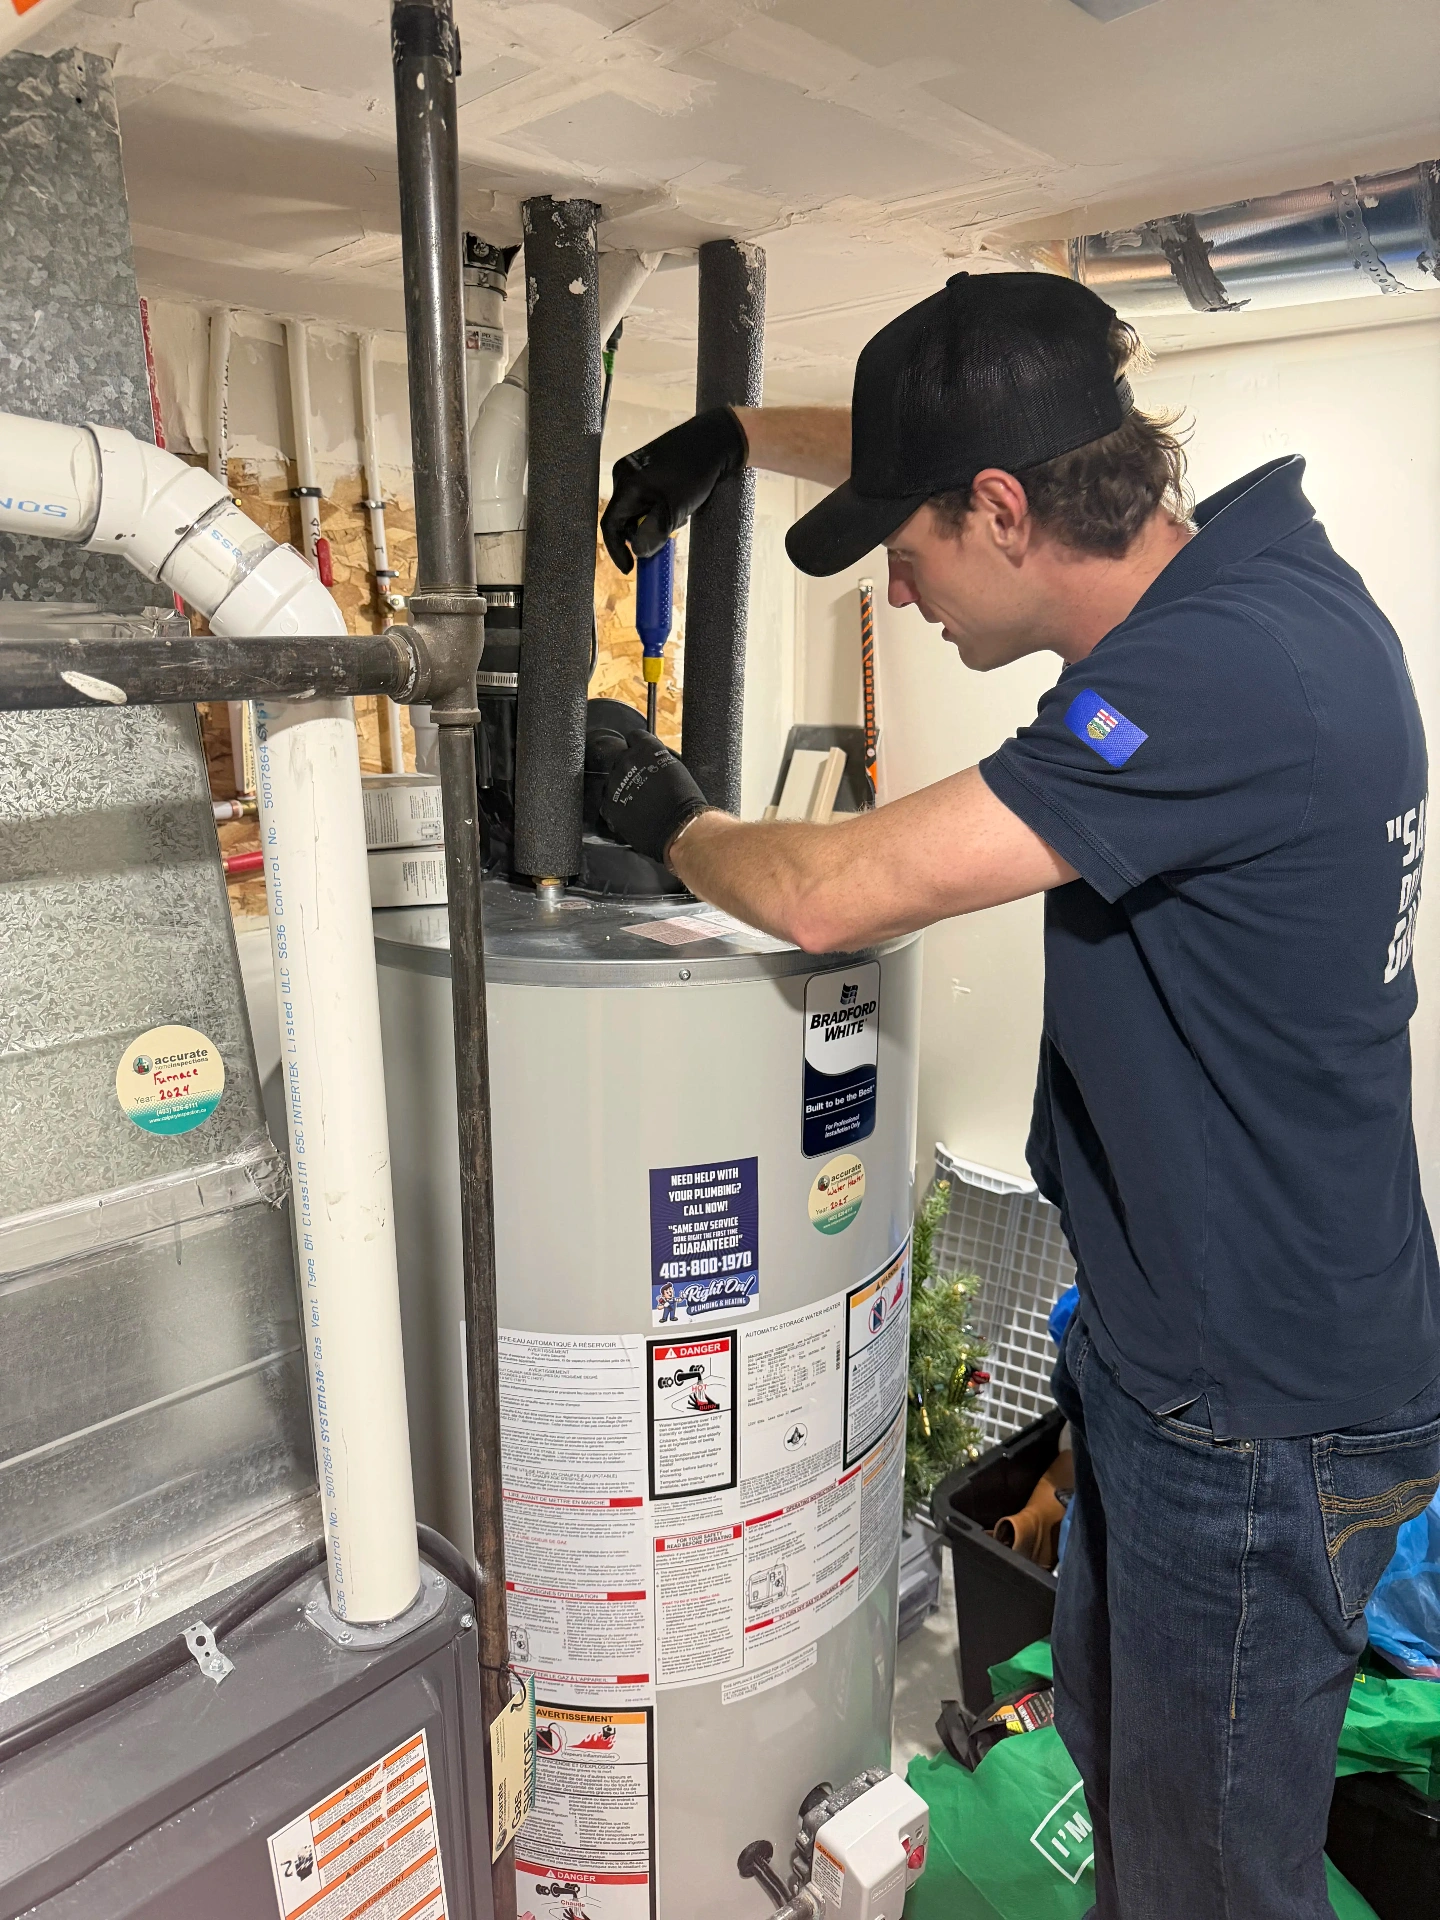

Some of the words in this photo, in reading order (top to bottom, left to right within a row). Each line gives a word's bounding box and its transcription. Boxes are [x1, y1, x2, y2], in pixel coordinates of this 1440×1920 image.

[260, 745, 274, 809] 5007864
[268, 820, 277, 845] No.
[269, 855, 284, 916] Control
[279, 924, 288, 959] S636
[281, 967, 291, 993] ULC
[810, 1001, 876, 1029] BRADFORD
[286, 1002, 298, 1053] Listed
[155, 1049, 208, 1065] accurate
[153, 1068, 198, 1085] Furnace
[159, 1084, 190, 1100] 2024
[289, 1061, 304, 1125] INTERTEK
[806, 1102, 823, 1114] Built
[826, 1100, 833, 1108] to
[835, 1096, 844, 1105] be
[847, 1092, 857, 1102] the
[825, 1124, 850, 1138] Installation
[851, 1121, 860, 1129] Only
[834, 1114, 860, 1128] Professional
[295, 1130, 305, 1153] 65C
[671, 1174, 693, 1187] NEED
[694, 1171, 716, 1184] HELP
[717, 1167, 739, 1181] WITH
[831, 1164, 861, 1181] accurate
[668, 1189, 693, 1202] YOUR
[694, 1182, 742, 1200] PLUMBING?
[683, 1204, 703, 1216] CALL
[705, 1200, 728, 1214] NOW!
[688, 1233, 702, 1241] RIGHT
[703, 1232, 712, 1240] THE
[713, 1230, 726, 1238] FIRST
[727, 1228, 738, 1237] TIME
[694, 1220, 709, 1232] DAY
[710, 1216, 739, 1230] SERVICE
[304, 1234, 313, 1252] BH
[307, 1257, 316, 1289] Type
[686, 1281, 725, 1302] Right
[725, 1274, 756, 1296] On!
[311, 1298, 320, 1328] Vent
[690, 1301, 719, 1313] PLUMBING
[725, 1297, 746, 1306] HEATING
[745, 1325, 778, 1338] AUTOMATIC
[779, 1316, 804, 1329] STORAGE
[805, 1310, 823, 1320] WATER
[823, 1302, 841, 1314] HEATER
[314, 1337, 323, 1360] Gas
[526, 1339, 572, 1348] AUTOMATIQUE
[578, 1340, 617, 1348] RÉSERVOIR
[680, 1342, 721, 1356] DANGER
[692, 1384, 707, 1392] HOT
[323, 1446, 336, 1499] 5007864
[521, 1494, 538, 1502] AVANT
[786, 1499, 809, 1513] OPERATING
[810, 1484, 837, 1501] INSTRUCTIONS
[328, 1507, 339, 1528] No.
[703, 1531, 723, 1539] SAFETY
[703, 1534, 732, 1544] OPERATING
[330, 1534, 345, 1584] Control
[522, 1587, 556, 1596] CONSIGNES
[336, 1589, 347, 1620] S636
[733, 1677, 753, 1687] APPLIANCE
[536, 1709, 614, 1723] AVERTISSEMENT
[523, 1728, 534, 1815] SHUTOFF
[349, 1773, 406, 1820] AVERTISSMENT
[357, 1800, 406, 1839] ADVERNCIA
[512, 1789, 522, 1830] Gas
[1051, 1811, 1093, 1858] I'M
[557, 1871, 596, 1883] DANGER
[349, 1873, 406, 1920] AVERTISSEMENT
[560, 1900, 585, 1908] Chaude
